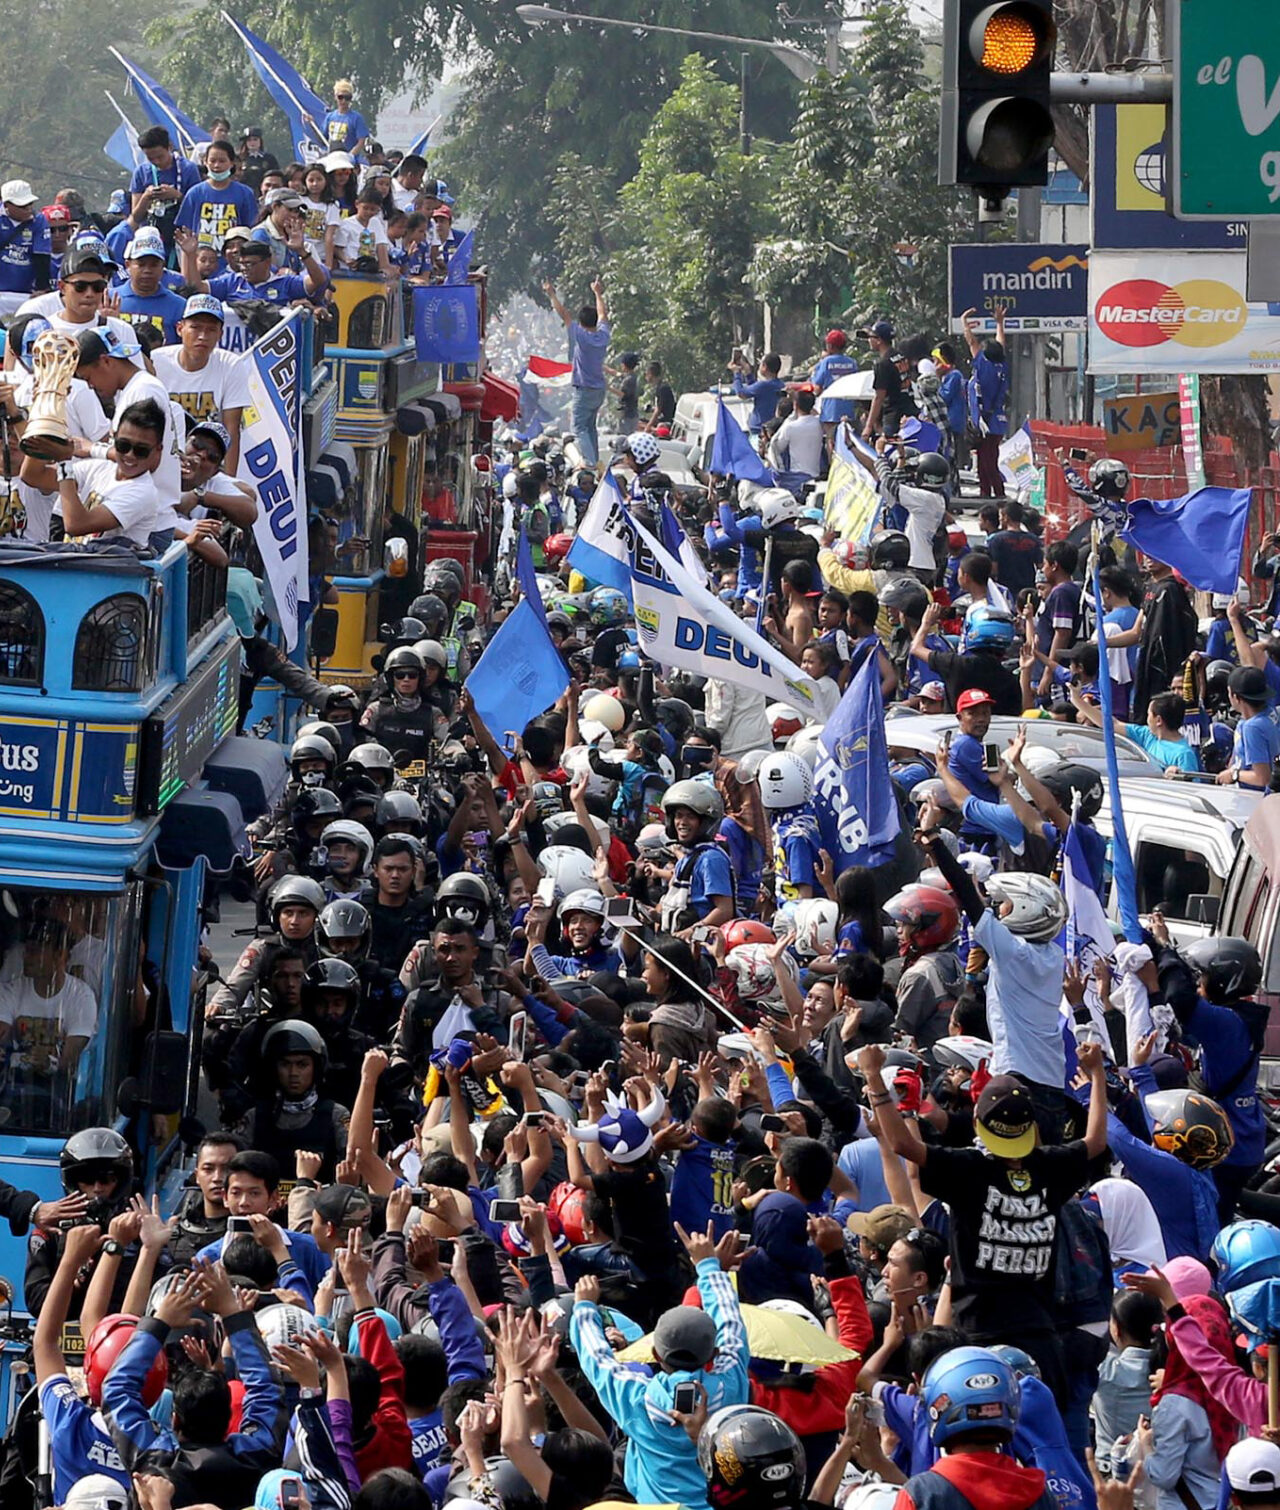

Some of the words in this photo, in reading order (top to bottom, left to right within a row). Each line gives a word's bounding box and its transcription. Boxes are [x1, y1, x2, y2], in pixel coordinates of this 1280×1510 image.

[200, 202, 238, 220] CHA
[982, 265, 1073, 290] mandiri
[983, 295, 1017, 310] atm
[1098, 305, 1244, 323] MasterCard
[87, 1446, 126, 1471] AB
